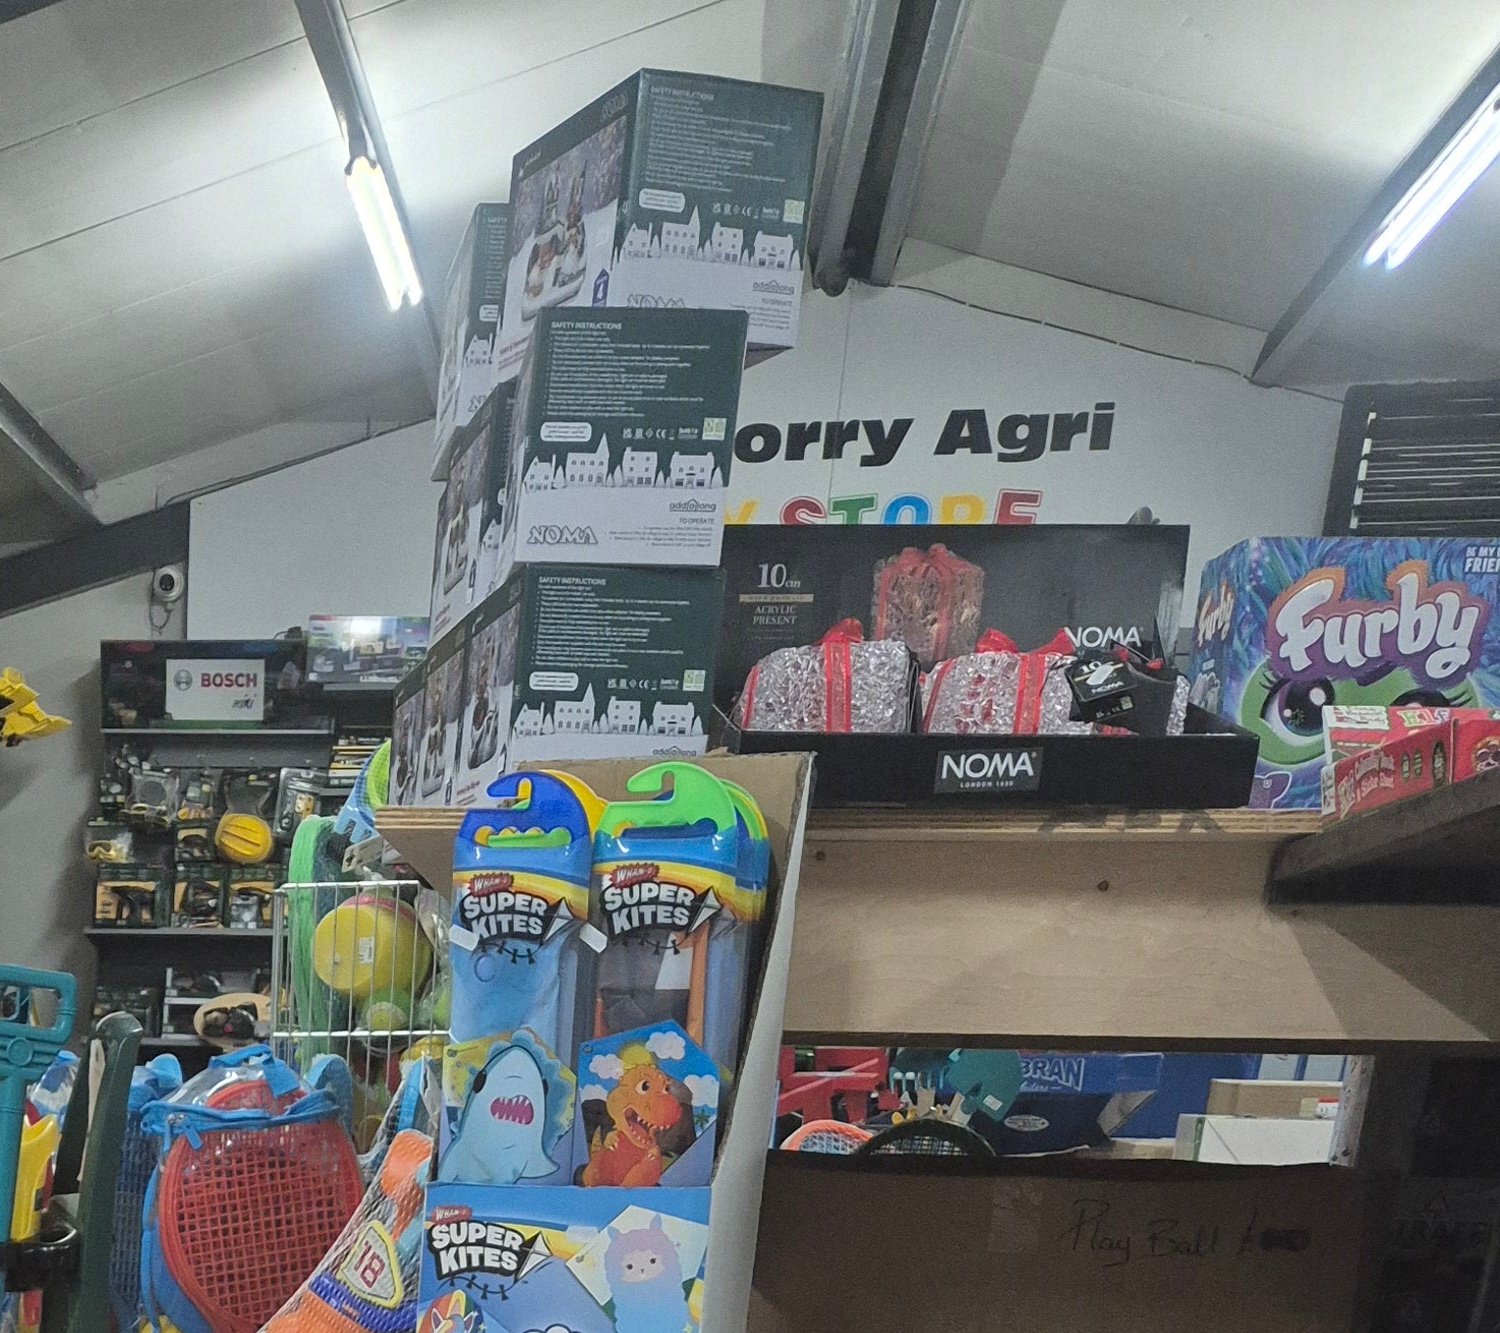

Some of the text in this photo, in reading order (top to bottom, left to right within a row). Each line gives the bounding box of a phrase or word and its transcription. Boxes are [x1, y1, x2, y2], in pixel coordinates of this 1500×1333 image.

[934, 402, 1116, 463] Agri
[527, 525, 598, 545] NOMA
[753, 615, 798, 625] PRESENT
[754, 604, 797, 614] ACRYLIC
[1064, 626, 1142, 648] NOMA
[1275, 572, 1480, 680] Furby
[201, 672, 258, 688] BOSCH
[941, 752, 1035, 779] NOMA
[463, 890, 548, 920] SUPER
[604, 881, 695, 912] SUPER
[471, 913, 544, 939] KITES
[611, 904, 691, 936] KITES
[431, 1221, 523, 1249] SUPER
[352, 1240, 386, 1290] 18
[440, 1245, 518, 1275] KITES
